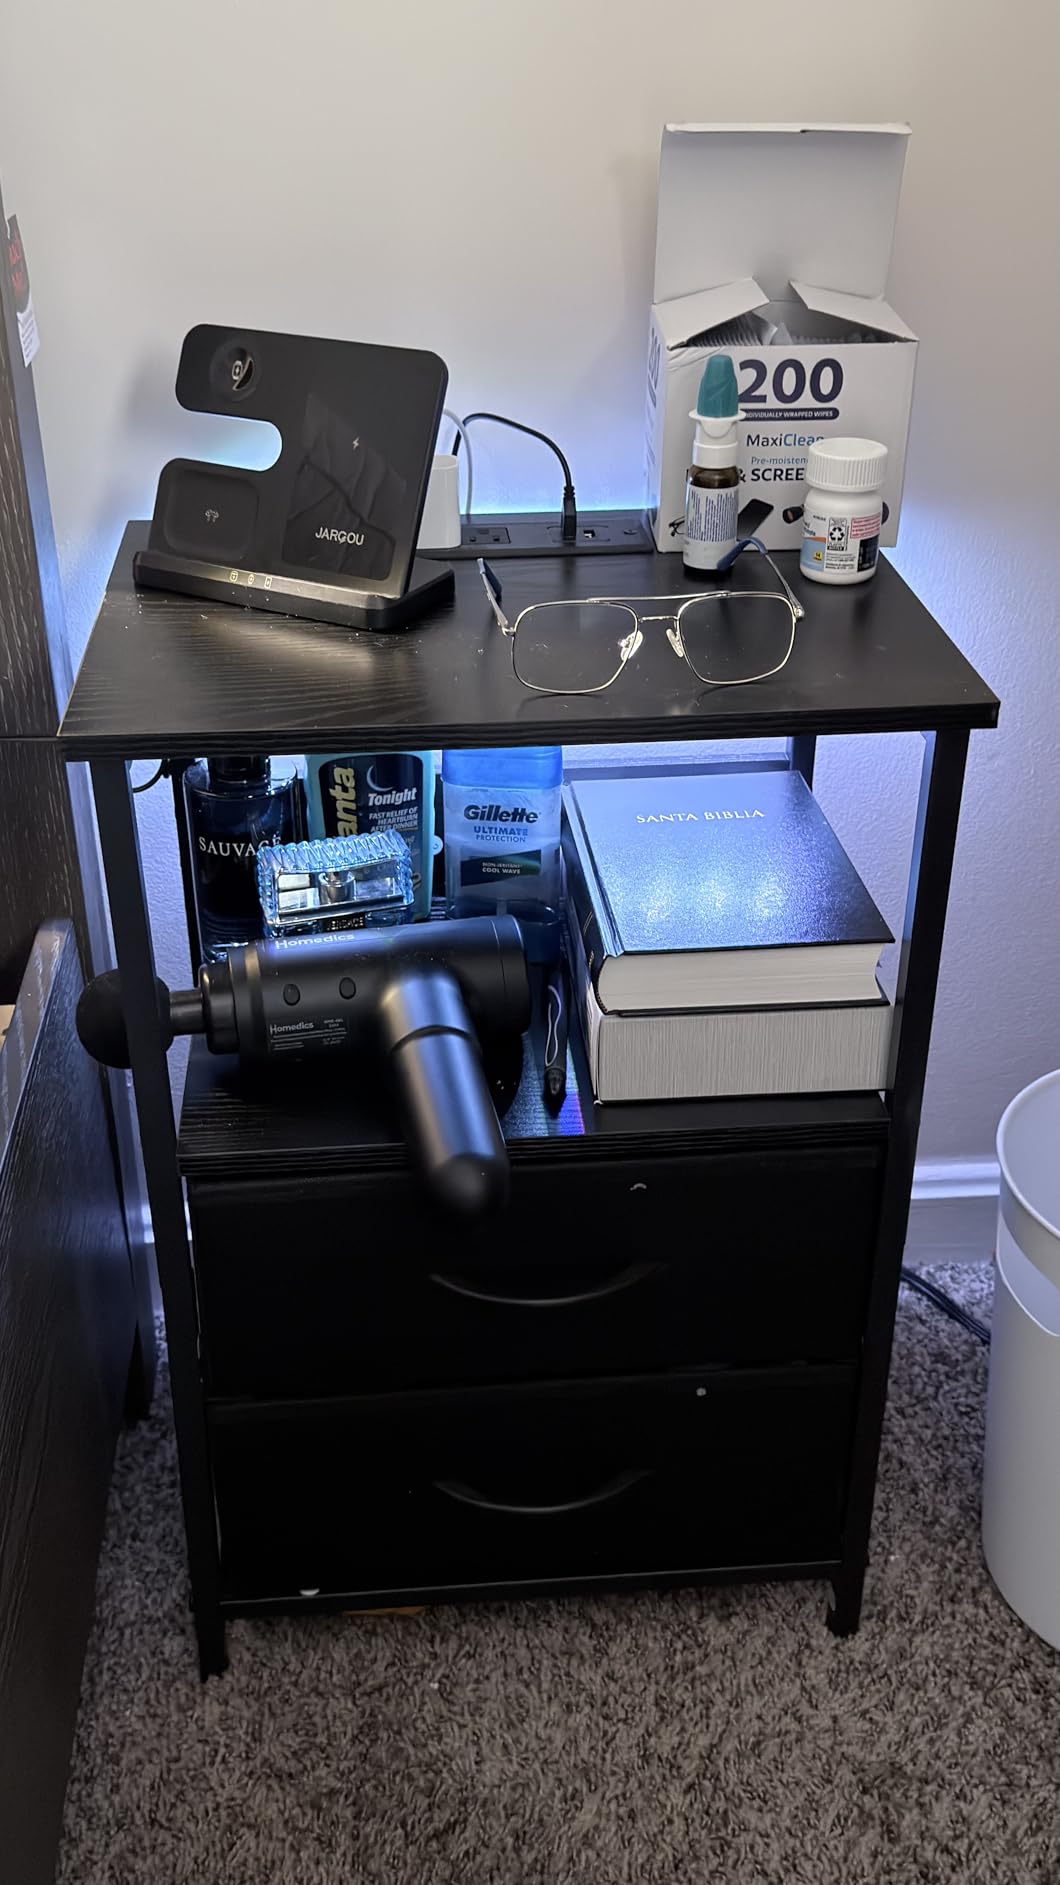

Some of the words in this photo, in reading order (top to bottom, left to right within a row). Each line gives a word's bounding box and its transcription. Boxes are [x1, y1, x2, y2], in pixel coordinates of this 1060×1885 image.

[738, 358, 844, 404] 200
[751, 456, 809, 465] Pre-moisten
[750, 467, 805, 482] SCREE
[315, 526, 365, 546] JARGOU
[328, 767, 358, 837] anta
[368, 787, 418, 806] Tonight
[369, 811, 386, 820] FAST
[386, 808, 408, 818] RELIEF
[408, 806, 419, 814] OF
[377, 813, 418, 825] HEARTBURN
[463, 804, 539, 824] Gillette
[636, 813, 699, 824] SANTA
[703, 809, 766, 820] BIBLIA
[392, 820, 418, 830] DINNER
[473, 825, 529, 836] ULTIMATE
[475, 834, 526, 843] PROTECTION
[198, 836, 281, 857] SAUVA
[274, 934, 356, 950] Homedics
[269, 1021, 315, 1035] Homedics
